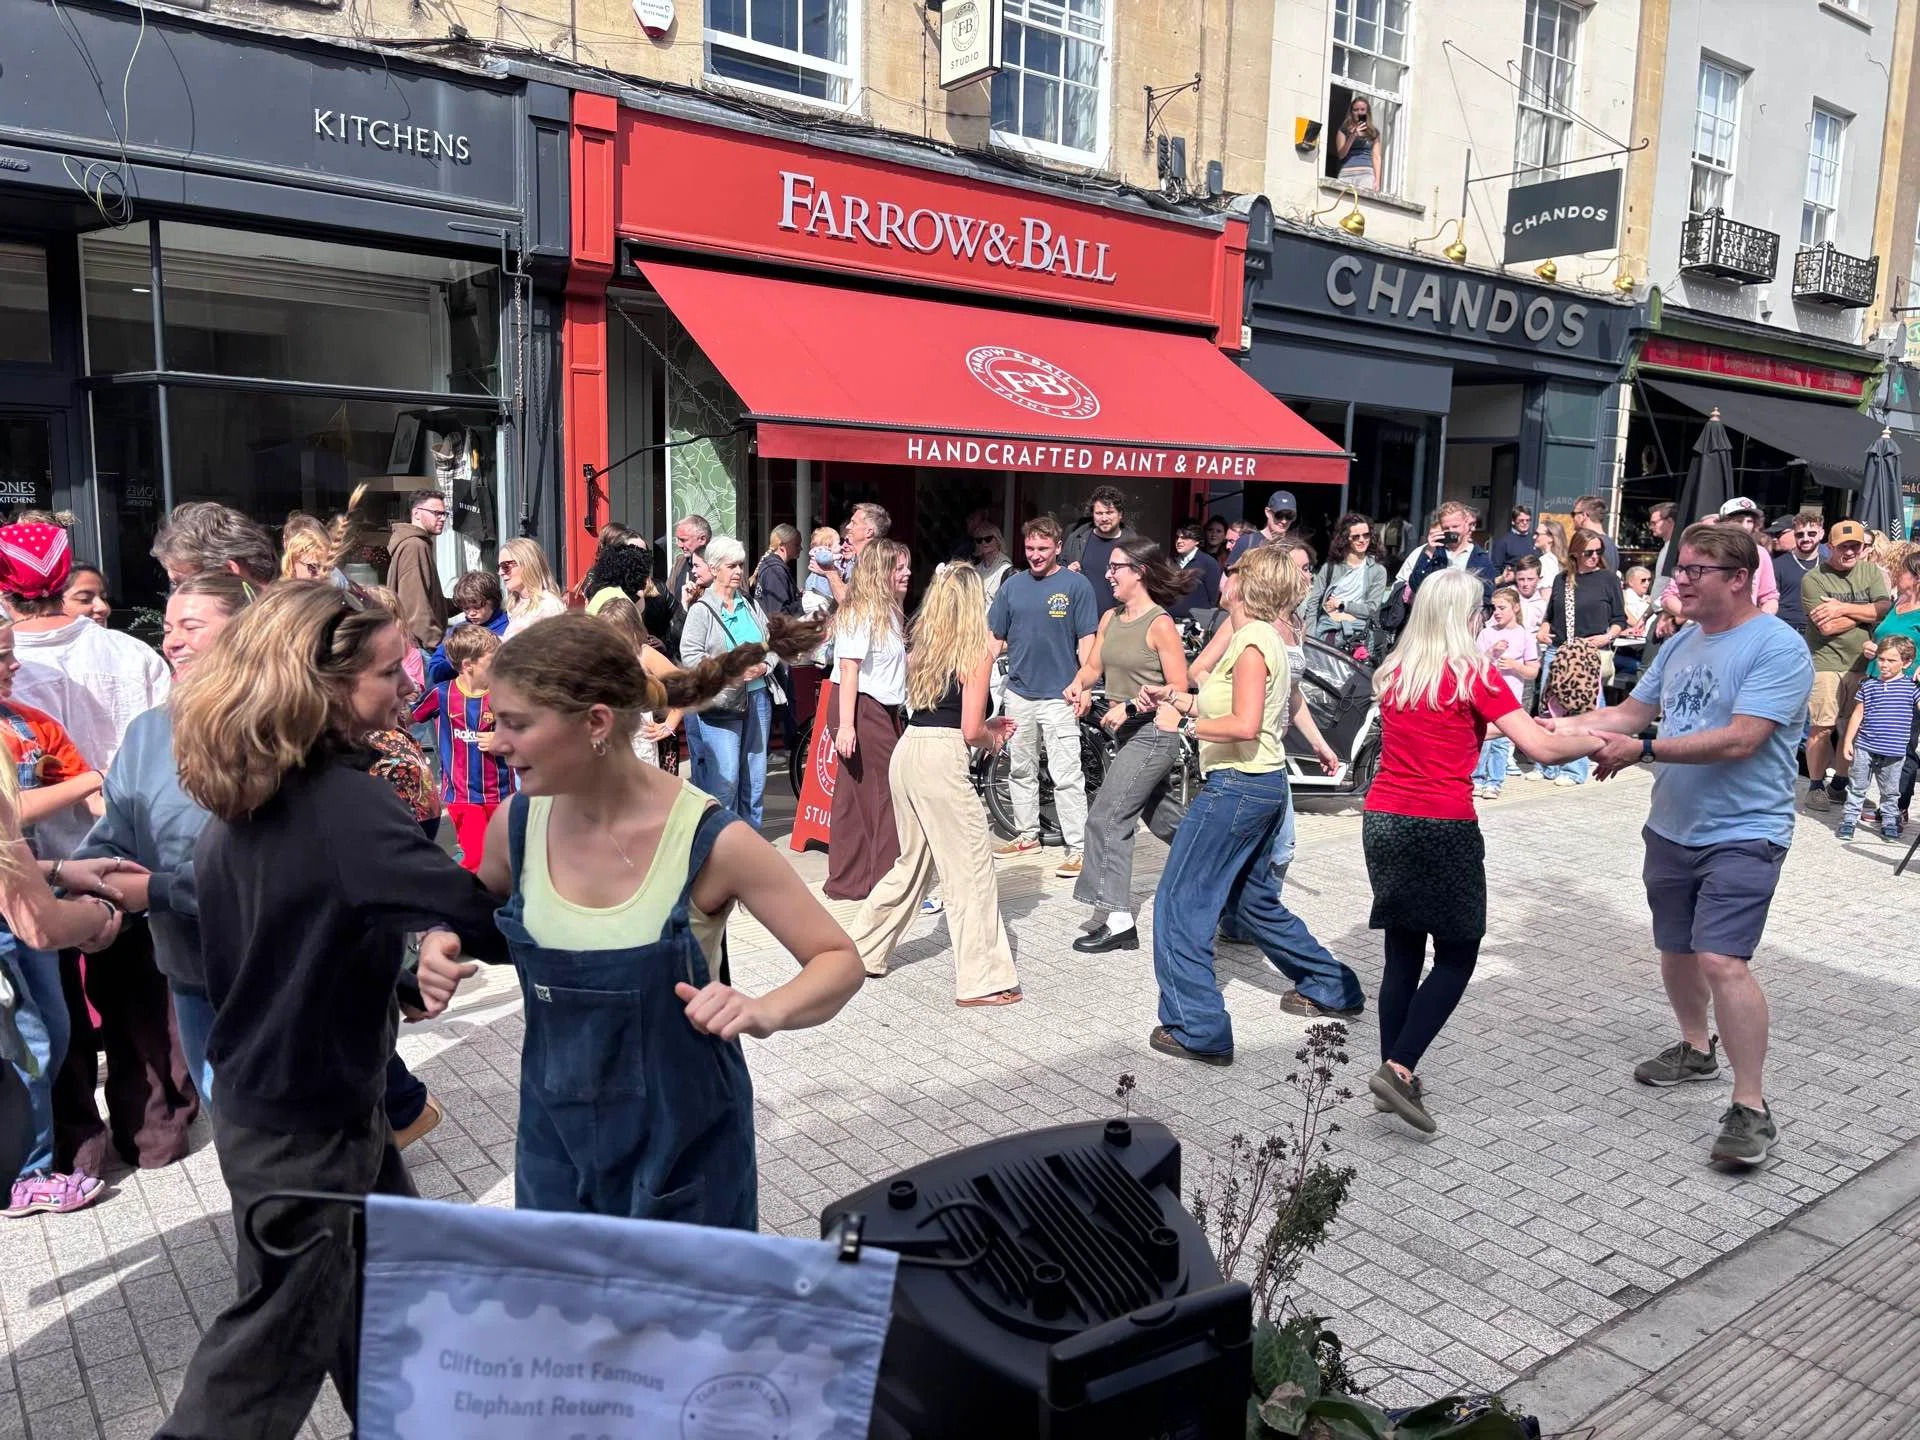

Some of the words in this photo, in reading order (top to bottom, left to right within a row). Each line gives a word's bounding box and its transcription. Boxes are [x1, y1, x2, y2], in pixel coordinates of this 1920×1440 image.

[951, 51, 979, 70] STUDIO
[314, 108, 470, 160] KITCHENS
[1511, 205, 1609, 236] CHANDOS
[1326, 255, 1590, 347] CHANDOS
[971, 349, 1006, 374] FARROW
[1031, 358, 1072, 383] BALL
[995, 369, 1069, 397] F&B
[907, 438, 1093, 469] HANDCRAFTED
[1102, 450, 1167, 472] PAINT
[1174, 454, 1188, 474] &
[1195, 455, 1256, 476] PAPER
[1543, 496, 1576, 510] CHAND
[804, 805, 831, 827] STU
[439, 1348, 524, 1379] Clifton's
[531, 1357, 584, 1380] Most
[591, 1360, 665, 1392] Famous
[454, 1391, 545, 1420] Elephant
[551, 1394, 636, 1419] Returns
